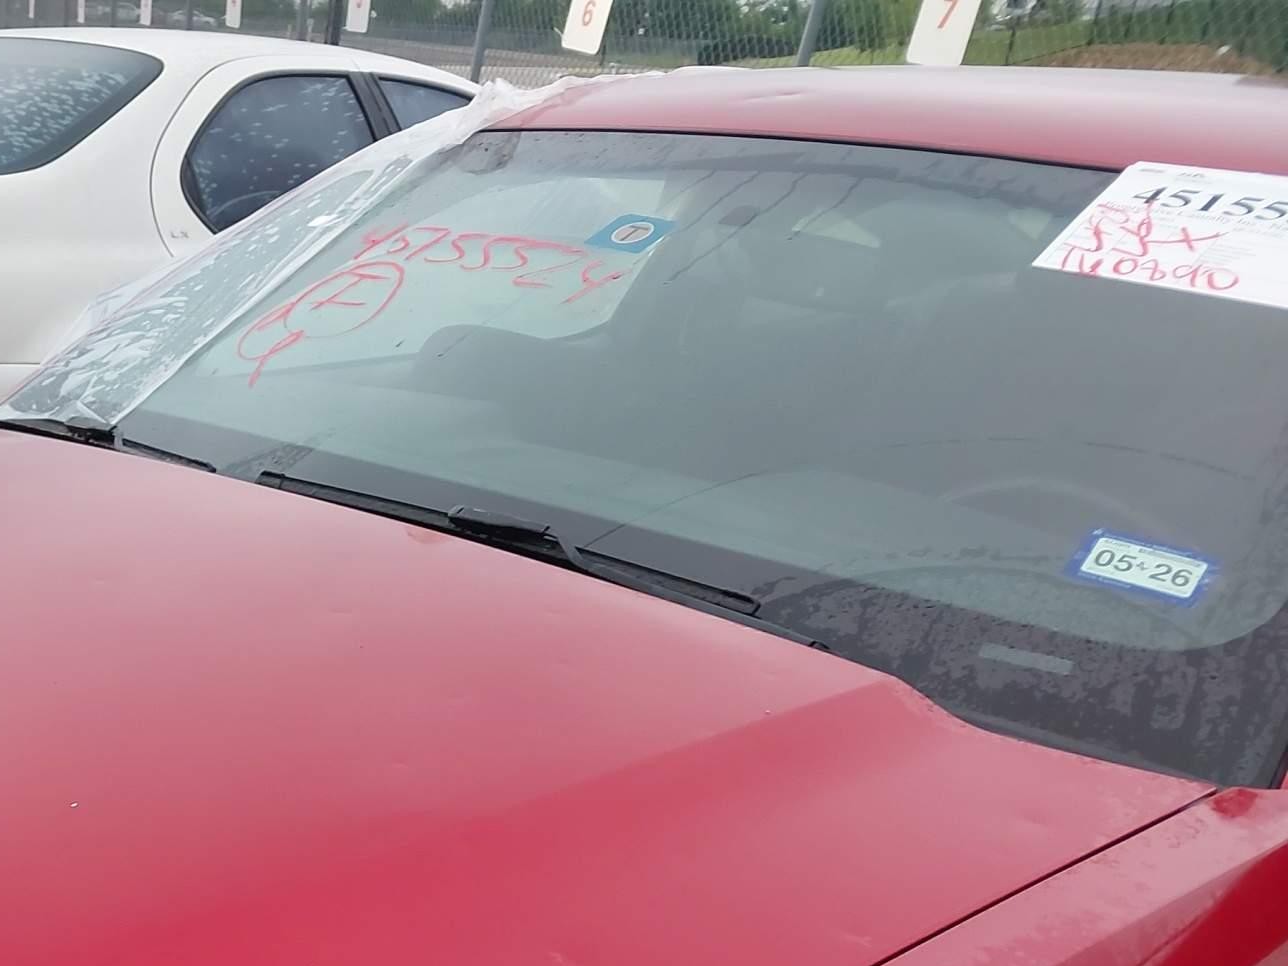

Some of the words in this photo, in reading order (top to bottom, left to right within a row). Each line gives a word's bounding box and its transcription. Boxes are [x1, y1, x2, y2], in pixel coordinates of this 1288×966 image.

[583, 0, 596, 26] 6
[937, 0, 959, 29] 7
[1094, 549, 1137, 572] 05
[1149, 563, 1193, 587] 26
